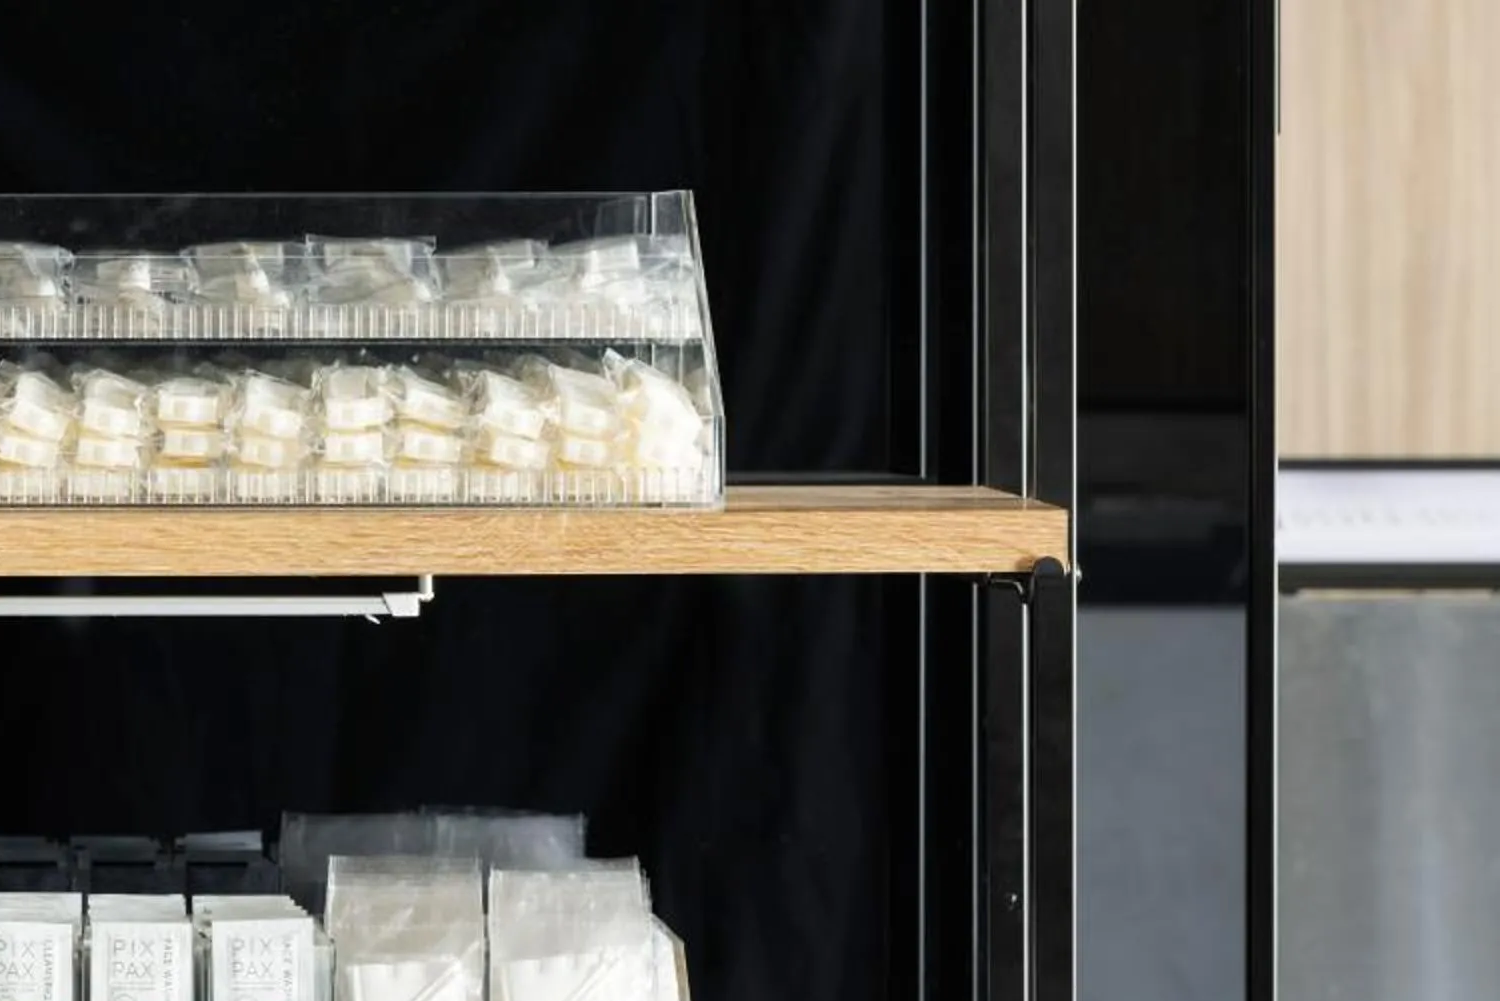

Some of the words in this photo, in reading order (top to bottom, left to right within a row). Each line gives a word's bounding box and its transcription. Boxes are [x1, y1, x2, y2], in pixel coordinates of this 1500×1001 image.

[113, 939, 154, 957] PIX
[231, 938, 274, 957] PIX
[112, 960, 155, 978] PAX
[231, 961, 274, 978] PAX
